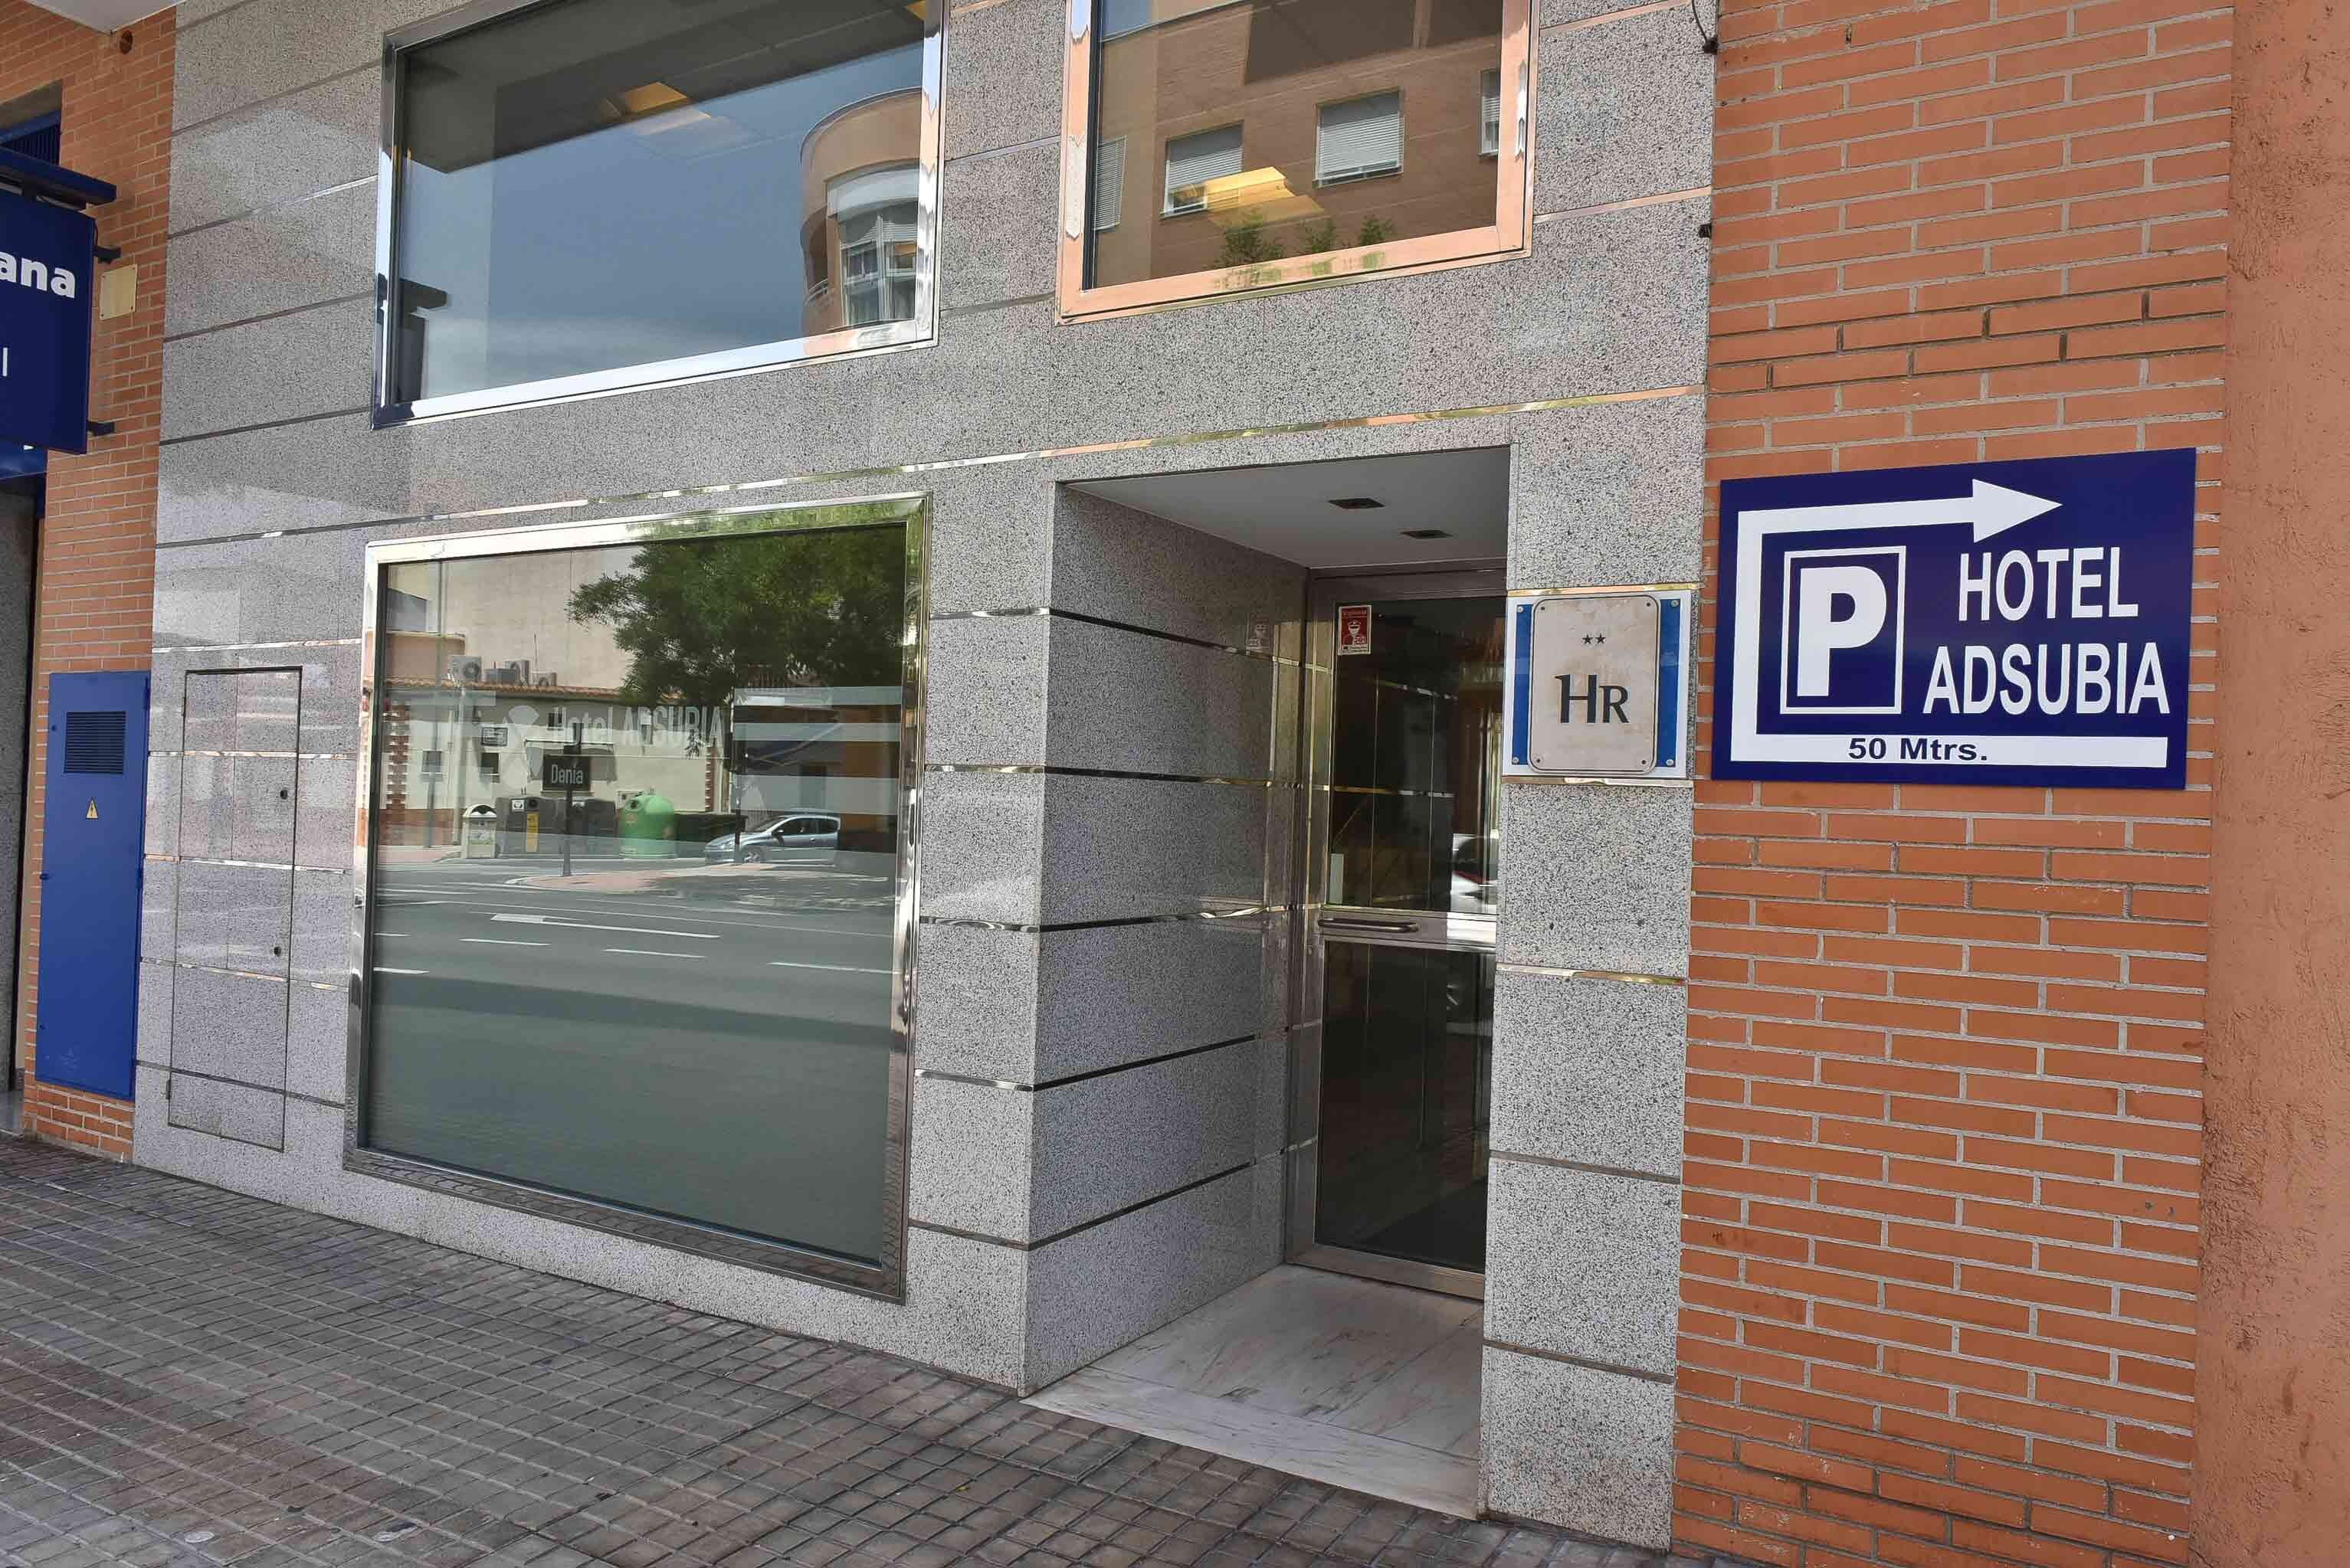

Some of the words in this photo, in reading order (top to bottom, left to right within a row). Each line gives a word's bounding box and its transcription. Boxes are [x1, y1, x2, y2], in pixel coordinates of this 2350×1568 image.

[1959, 547, 2138, 621] HOTEL
[1797, 566, 1886, 696] P
[1923, 643, 2170, 715] ADSUBIA
[1849, 738, 1886, 759] 50
[1900, 738, 1987, 761] Mtrs.
